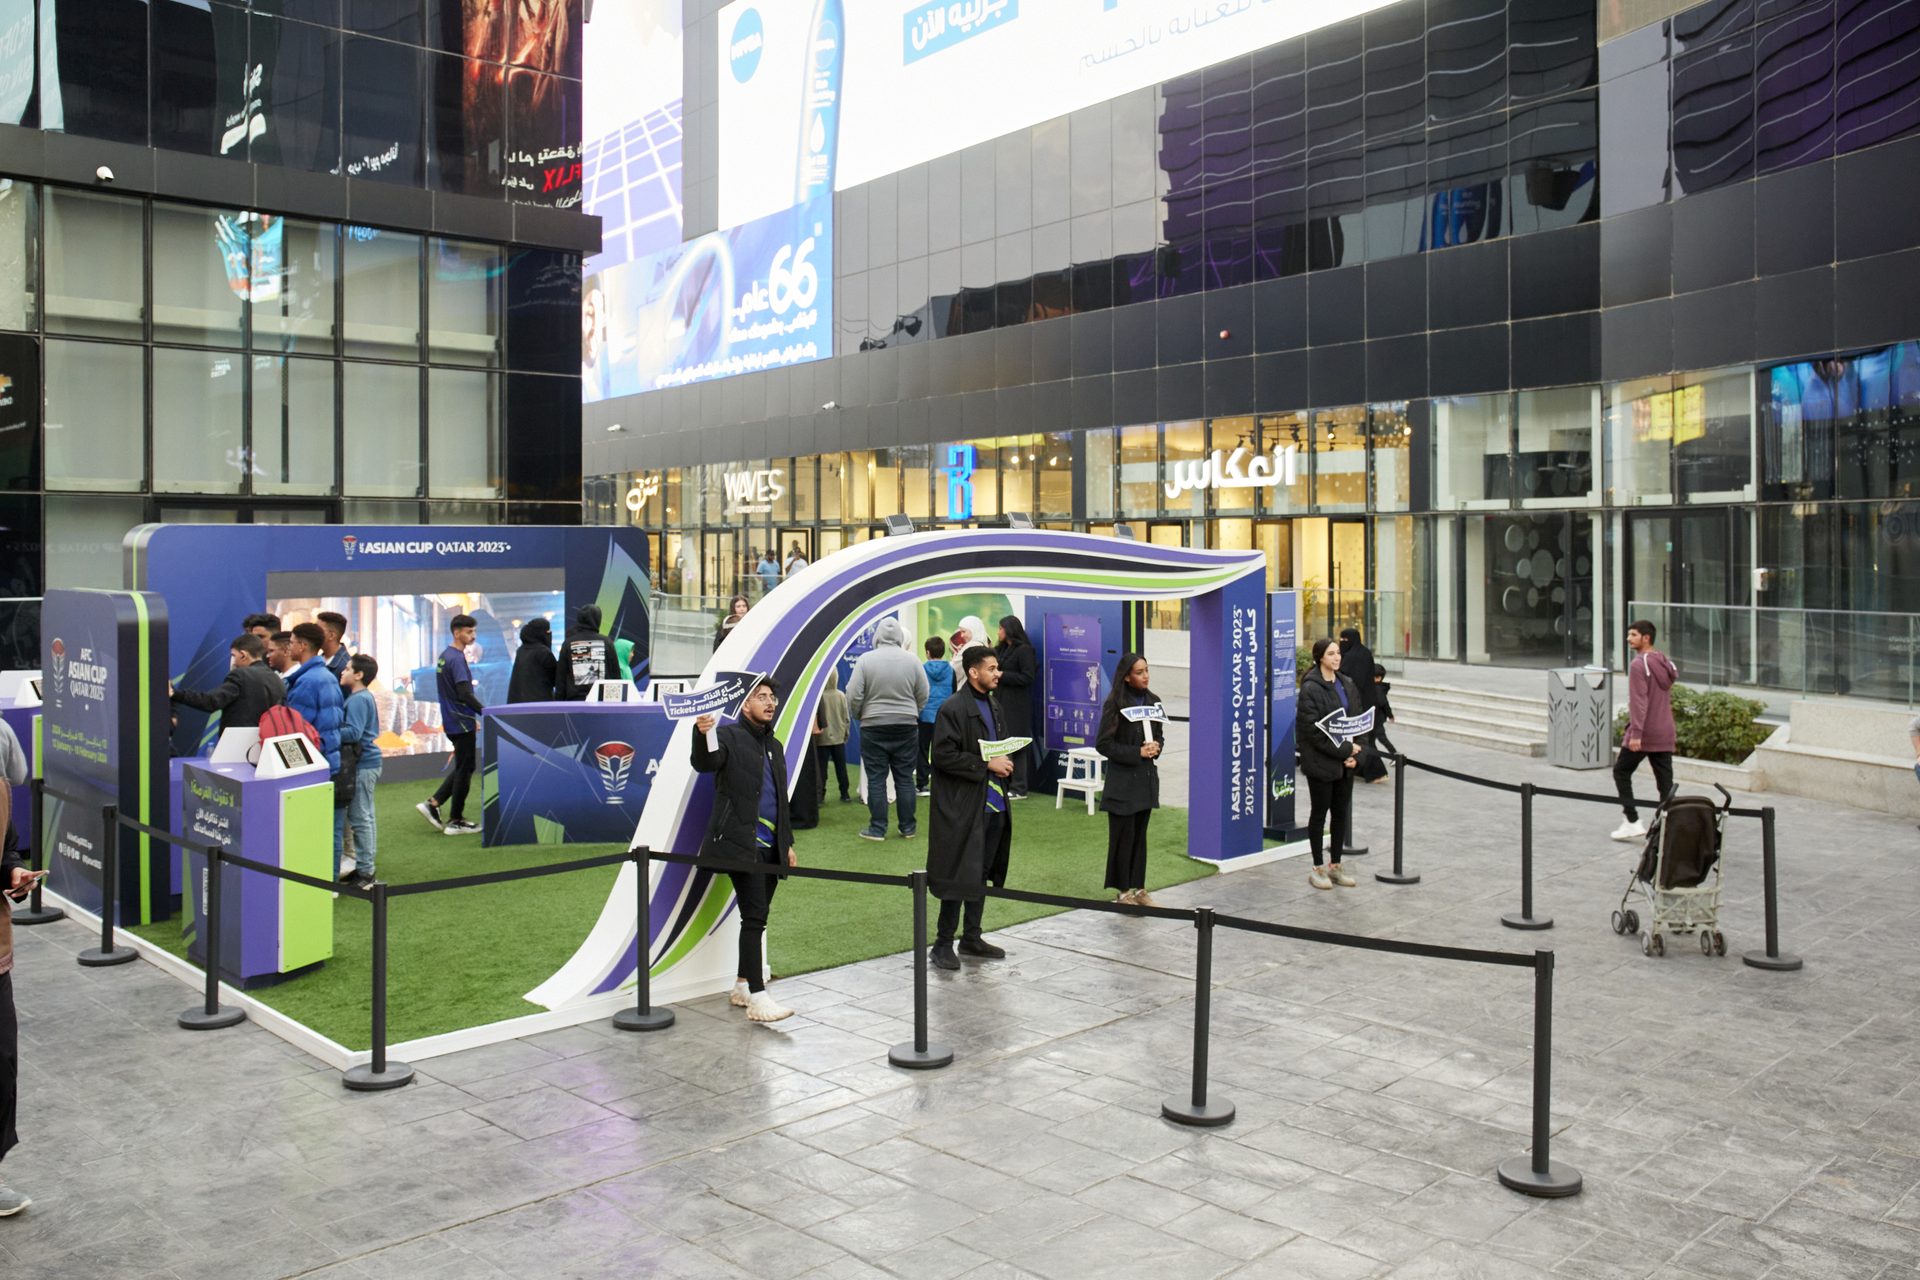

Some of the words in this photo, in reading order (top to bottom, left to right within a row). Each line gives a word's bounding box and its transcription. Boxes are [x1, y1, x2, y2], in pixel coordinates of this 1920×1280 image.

[912, 7, 945, 51] الآن
[768, 236, 818, 315] 66
[724, 469, 785, 502] WAVES
[1165, 444, 1297, 499] انعكاس
[364, 541, 405, 554] ASIAN
[406, 541, 433, 554] CUP
[436, 541, 474, 555] QATAR
[80, 648, 92, 662] AFC
[68, 660, 91, 681] ASIAN
[91, 665, 107, 684] CUP
[721, 677, 743, 697] تباع
[1232, 653, 1243, 708] QATAR
[70, 680, 90, 698] QATAR
[669, 698, 692, 706] هنا
[670, 706, 696, 716] Tickets
[696, 696, 729, 711] available
[728, 688, 745, 700] here
[693, 690, 720, 706] التذاكر
[1232, 722, 1241, 757] CUP
[1232, 760, 1241, 812] ASIAN
[1245, 775, 1254, 815] 2023
